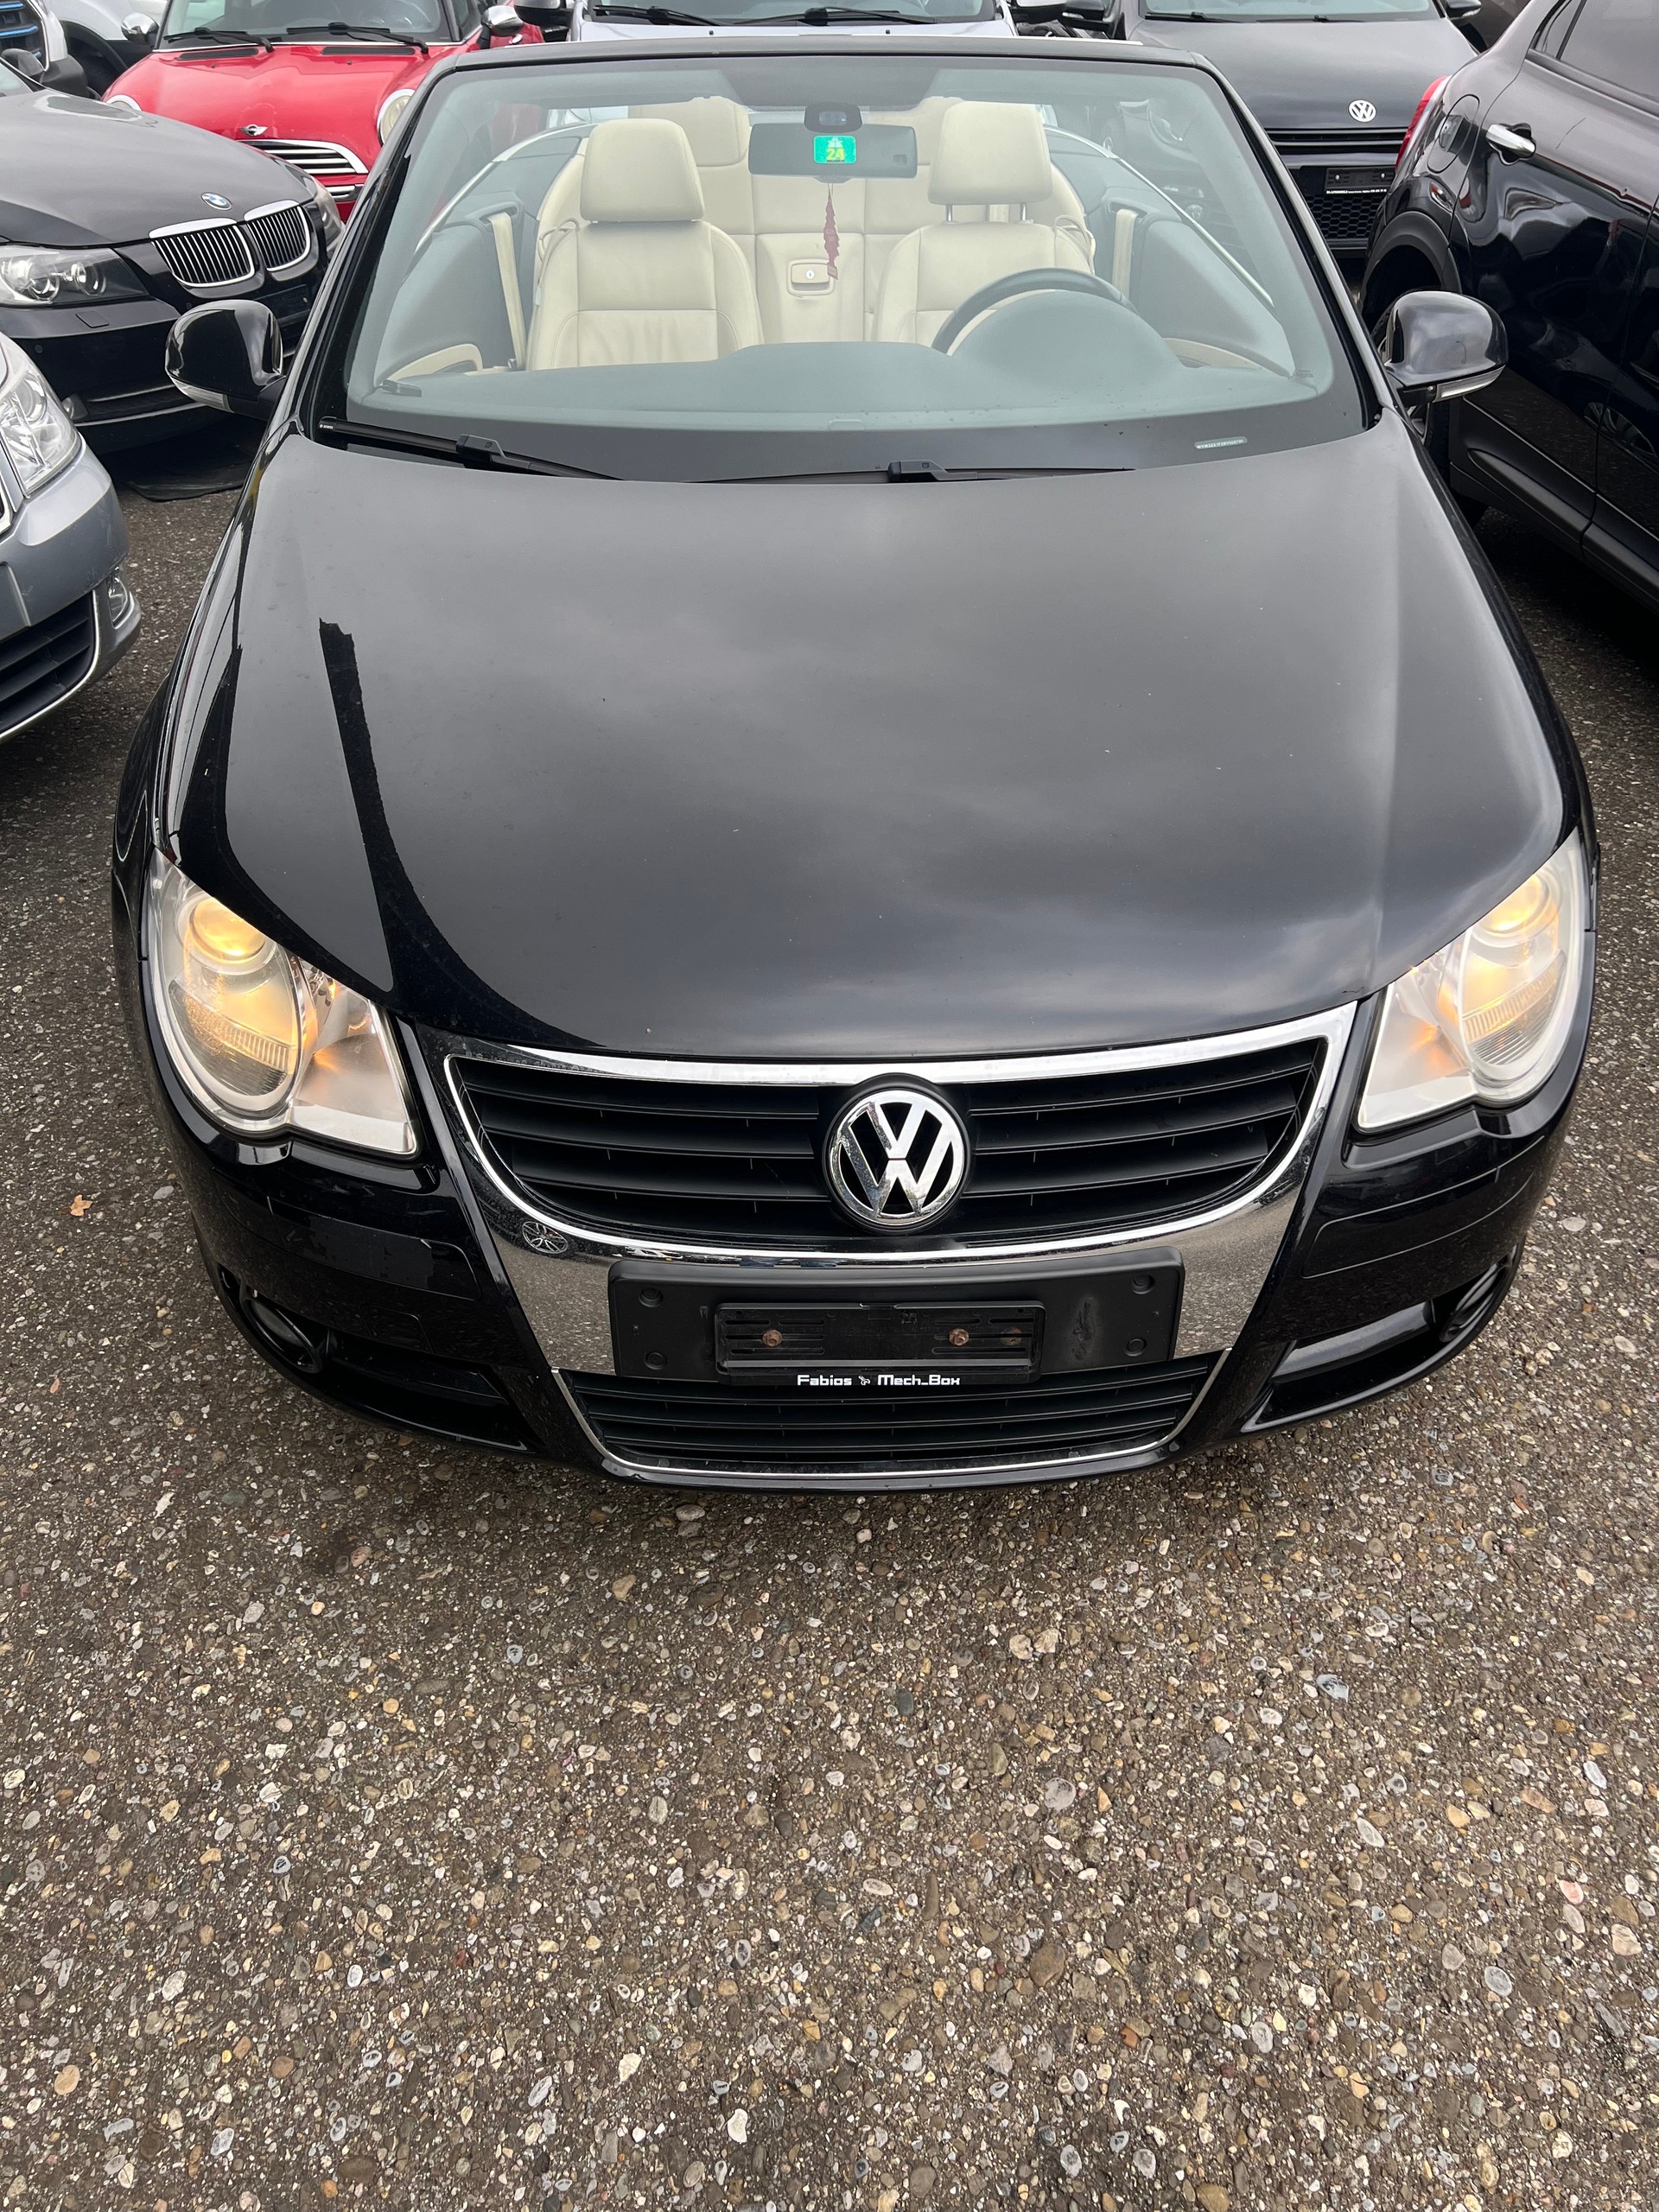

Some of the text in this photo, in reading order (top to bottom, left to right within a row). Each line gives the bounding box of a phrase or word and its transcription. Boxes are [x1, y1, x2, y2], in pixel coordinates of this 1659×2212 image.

[1349, 100, 1376, 122] VW
[826, 148, 844, 161] 24
[832, 1092, 963, 1224] VW
[797, 1374, 961, 1386] Fabios Mech_Box
